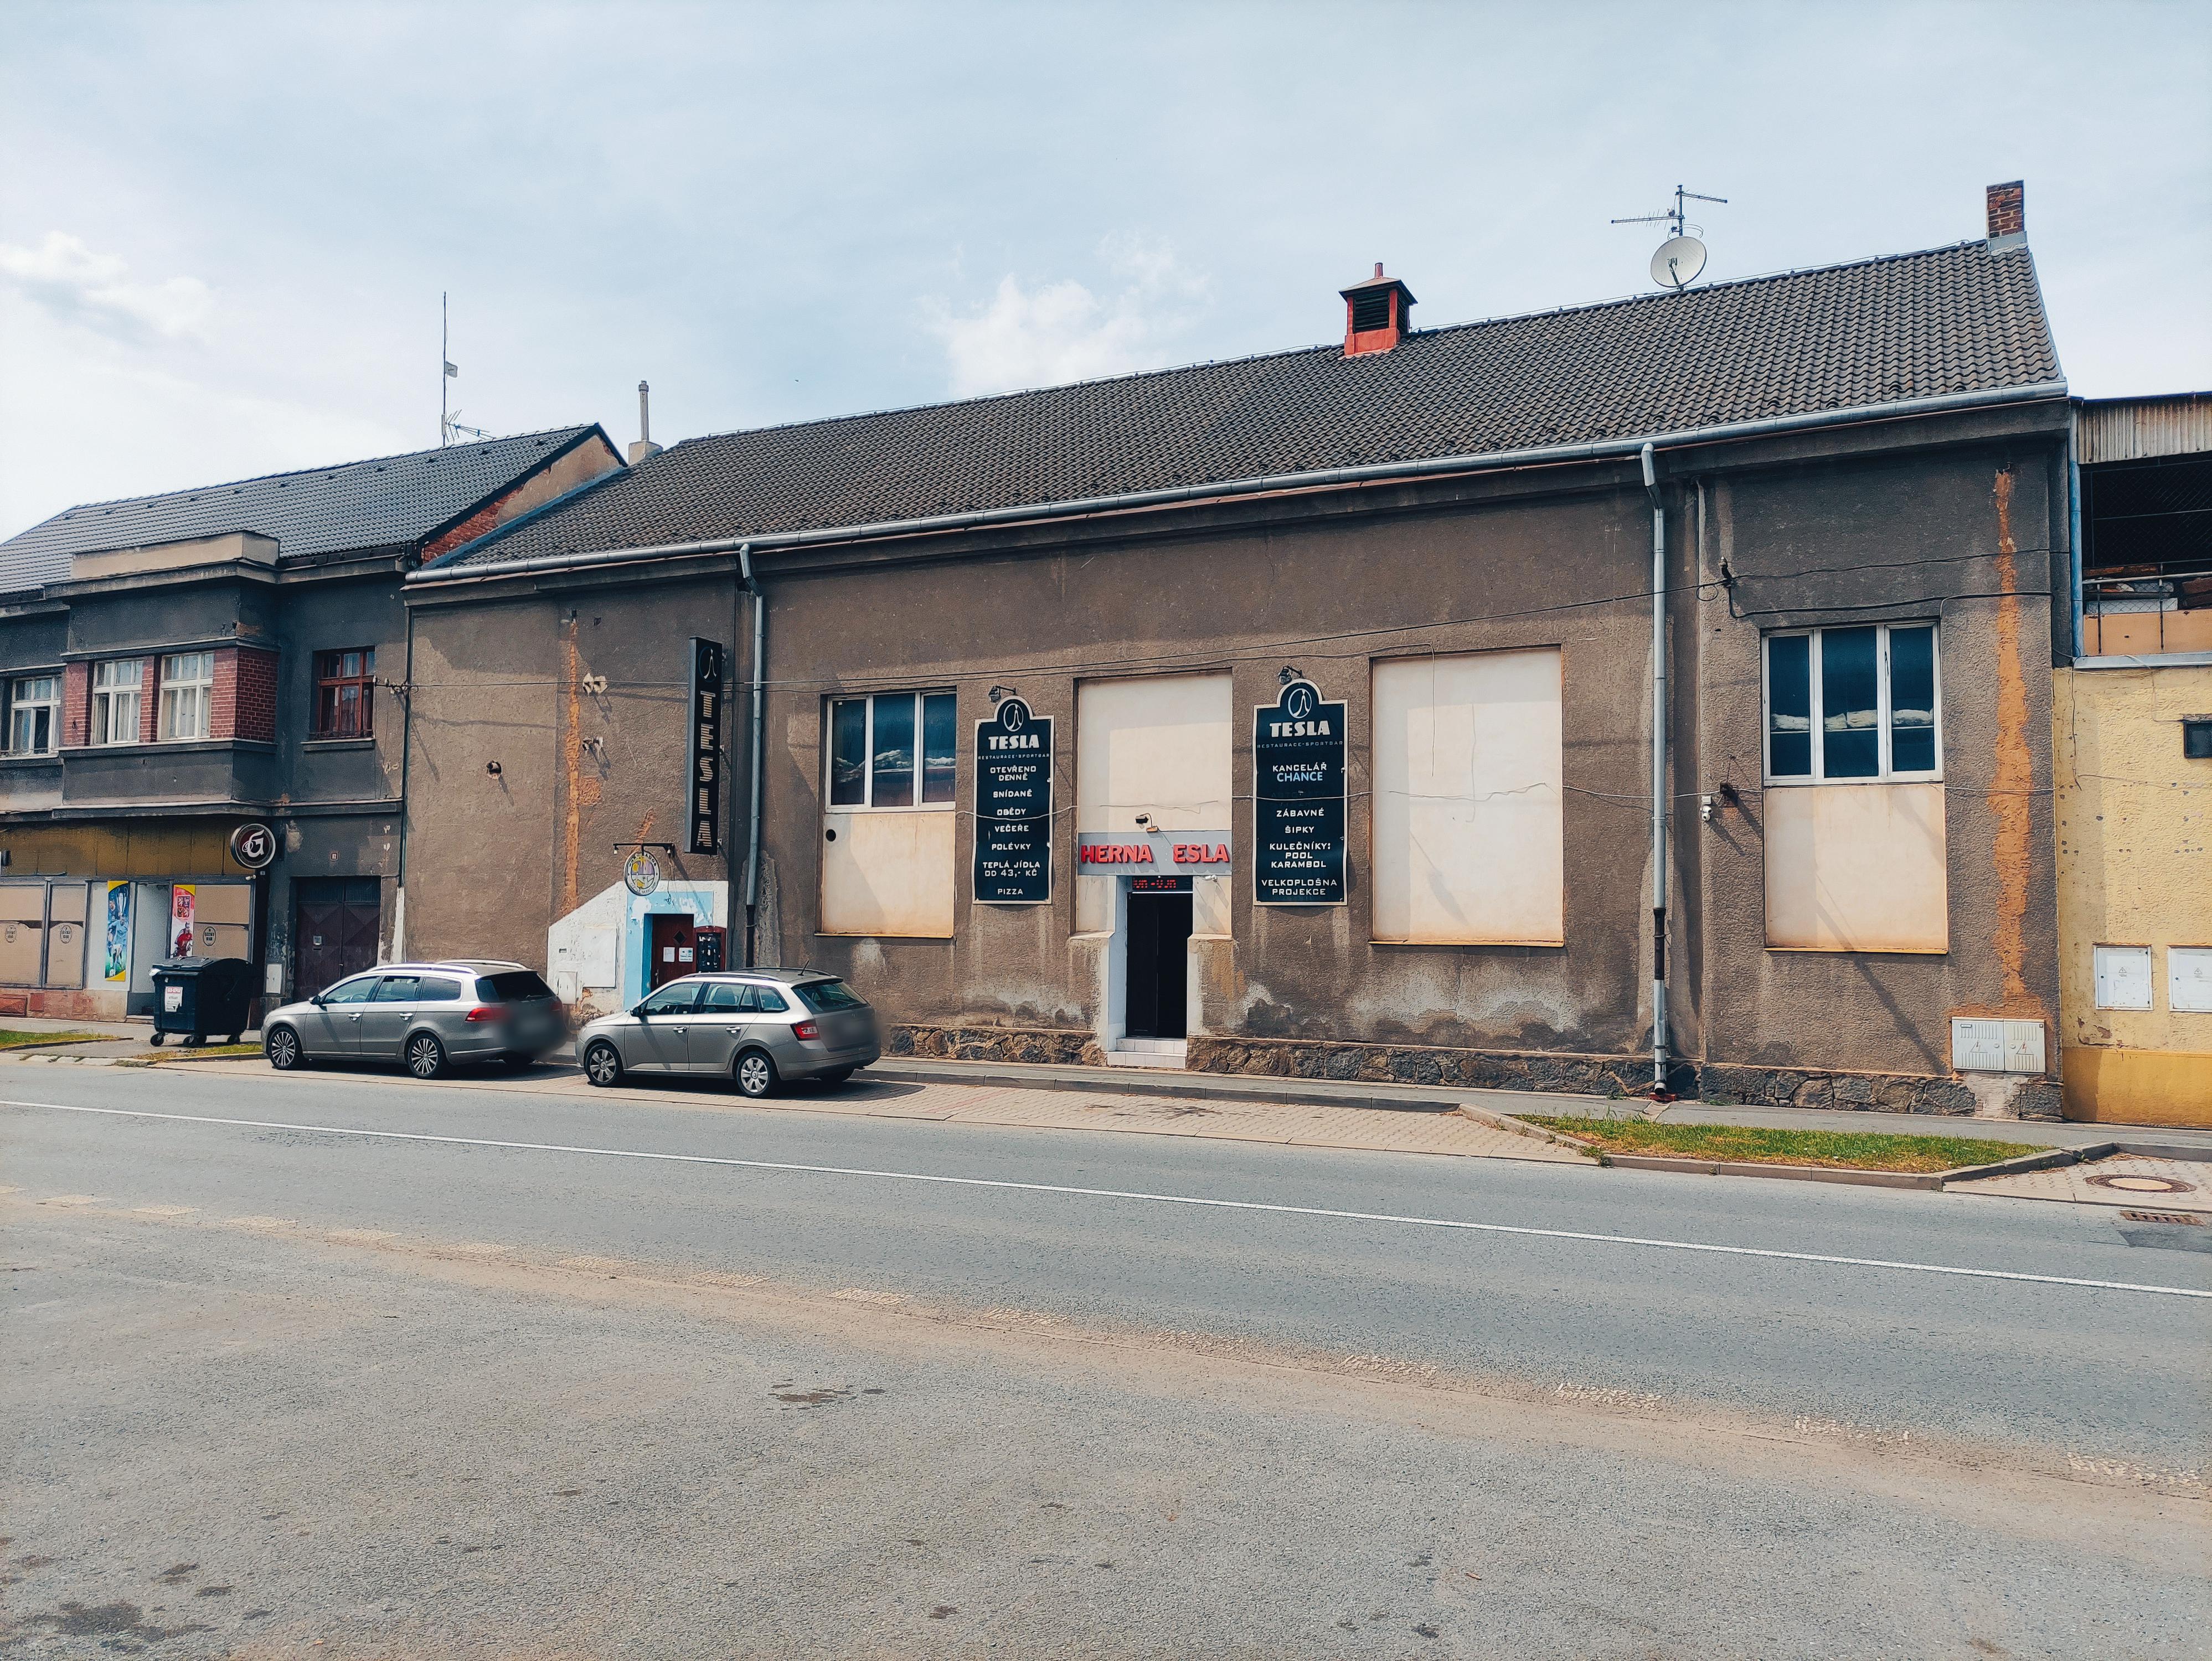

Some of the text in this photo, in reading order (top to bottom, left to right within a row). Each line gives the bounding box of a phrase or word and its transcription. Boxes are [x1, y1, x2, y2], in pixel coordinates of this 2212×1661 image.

[1270, 720, 1331, 737] TESLA
[988, 734, 1040, 750] TESLA
[697, 690, 715, 847] TESLA
[990, 765, 1037, 774] OTEVŘENO
[1272, 762, 1327, 772] KANCELÁŘ
[998, 773, 1028, 781] DENNĚ
[1276, 771, 1323, 782] CHANCE
[993, 788, 1033, 798] SNÍDANĚ
[997, 807, 1027, 816] OBĚDY
[1276, 807, 1324, 817] ZÁBAVNÉ
[994, 824, 1029, 832] VEČEŘE
[1285, 825, 1314, 834] ŠIPKY
[991, 842, 1031, 850] POLÉVKY
[1269, 840, 1331, 850] KULEČNÍKY:
[1080, 844, 1230, 863] HERNA ESLA
[982, 860, 1040, 869] TEPLÁ JÍDLA
[1001, 869, 1021, 878] 43,-
[1025, 868, 1037, 876] KČ
[1261, 878, 1337, 886] VELKOPLOŠNA
